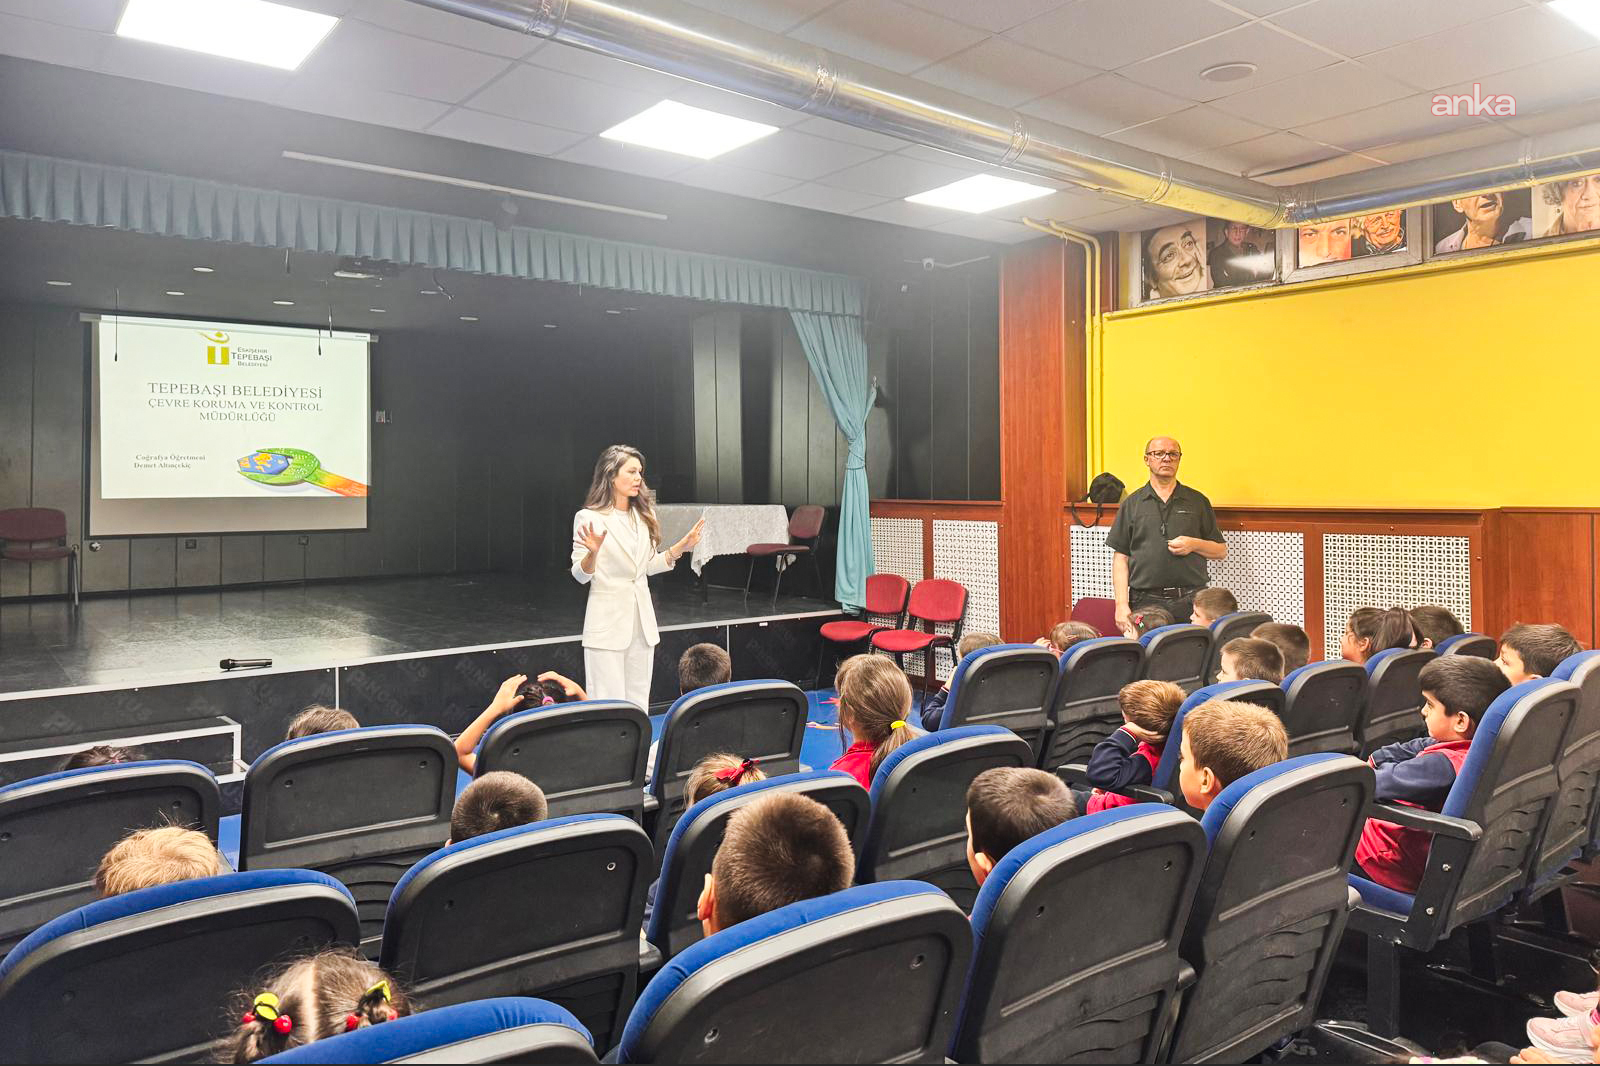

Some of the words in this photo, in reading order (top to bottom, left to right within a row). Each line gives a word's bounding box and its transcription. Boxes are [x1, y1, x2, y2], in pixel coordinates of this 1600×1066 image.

[147, 382, 226, 397] TEPEBAŞI
[232, 384, 322, 399] BELEDİYESİ
[148, 398, 190, 409] ÇEVRE
[193, 400, 247, 410] KORUMA
[250, 401, 265, 410] VE
[268, 402, 323, 412] KONTROL
[200, 410, 276, 422] MÜDÜRLÜĞÜ
